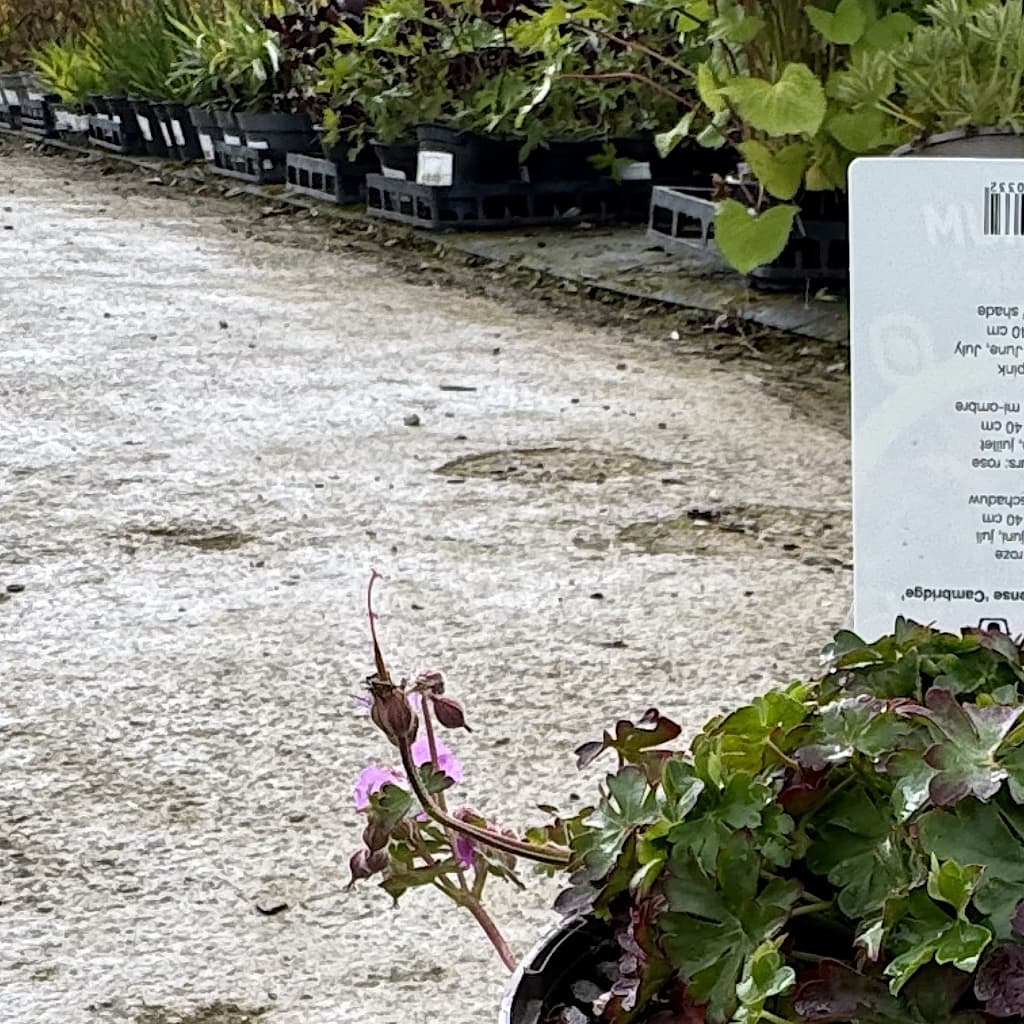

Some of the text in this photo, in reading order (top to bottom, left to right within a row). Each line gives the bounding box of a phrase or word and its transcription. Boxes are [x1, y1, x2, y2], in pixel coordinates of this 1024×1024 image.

[977, 305, 1019, 319] shade
[987, 326, 1008, 336] cm
[954, 340, 982, 357] July
[986, 343, 1023, 358] June,
[955, 401, 1020, 415] mi-ombre
[981, 421, 1002, 431] cm
[1006, 421, 1023, 434] 40
[980, 437, 1015, 452] juillet
[972, 458, 1001, 468] rose
[982, 513, 1003, 523] cm
[1006, 514, 1023, 526] 40
[976, 530, 995, 544] juli
[999, 530, 1024, 544] juni,
[995, 550, 1023, 560] roze
